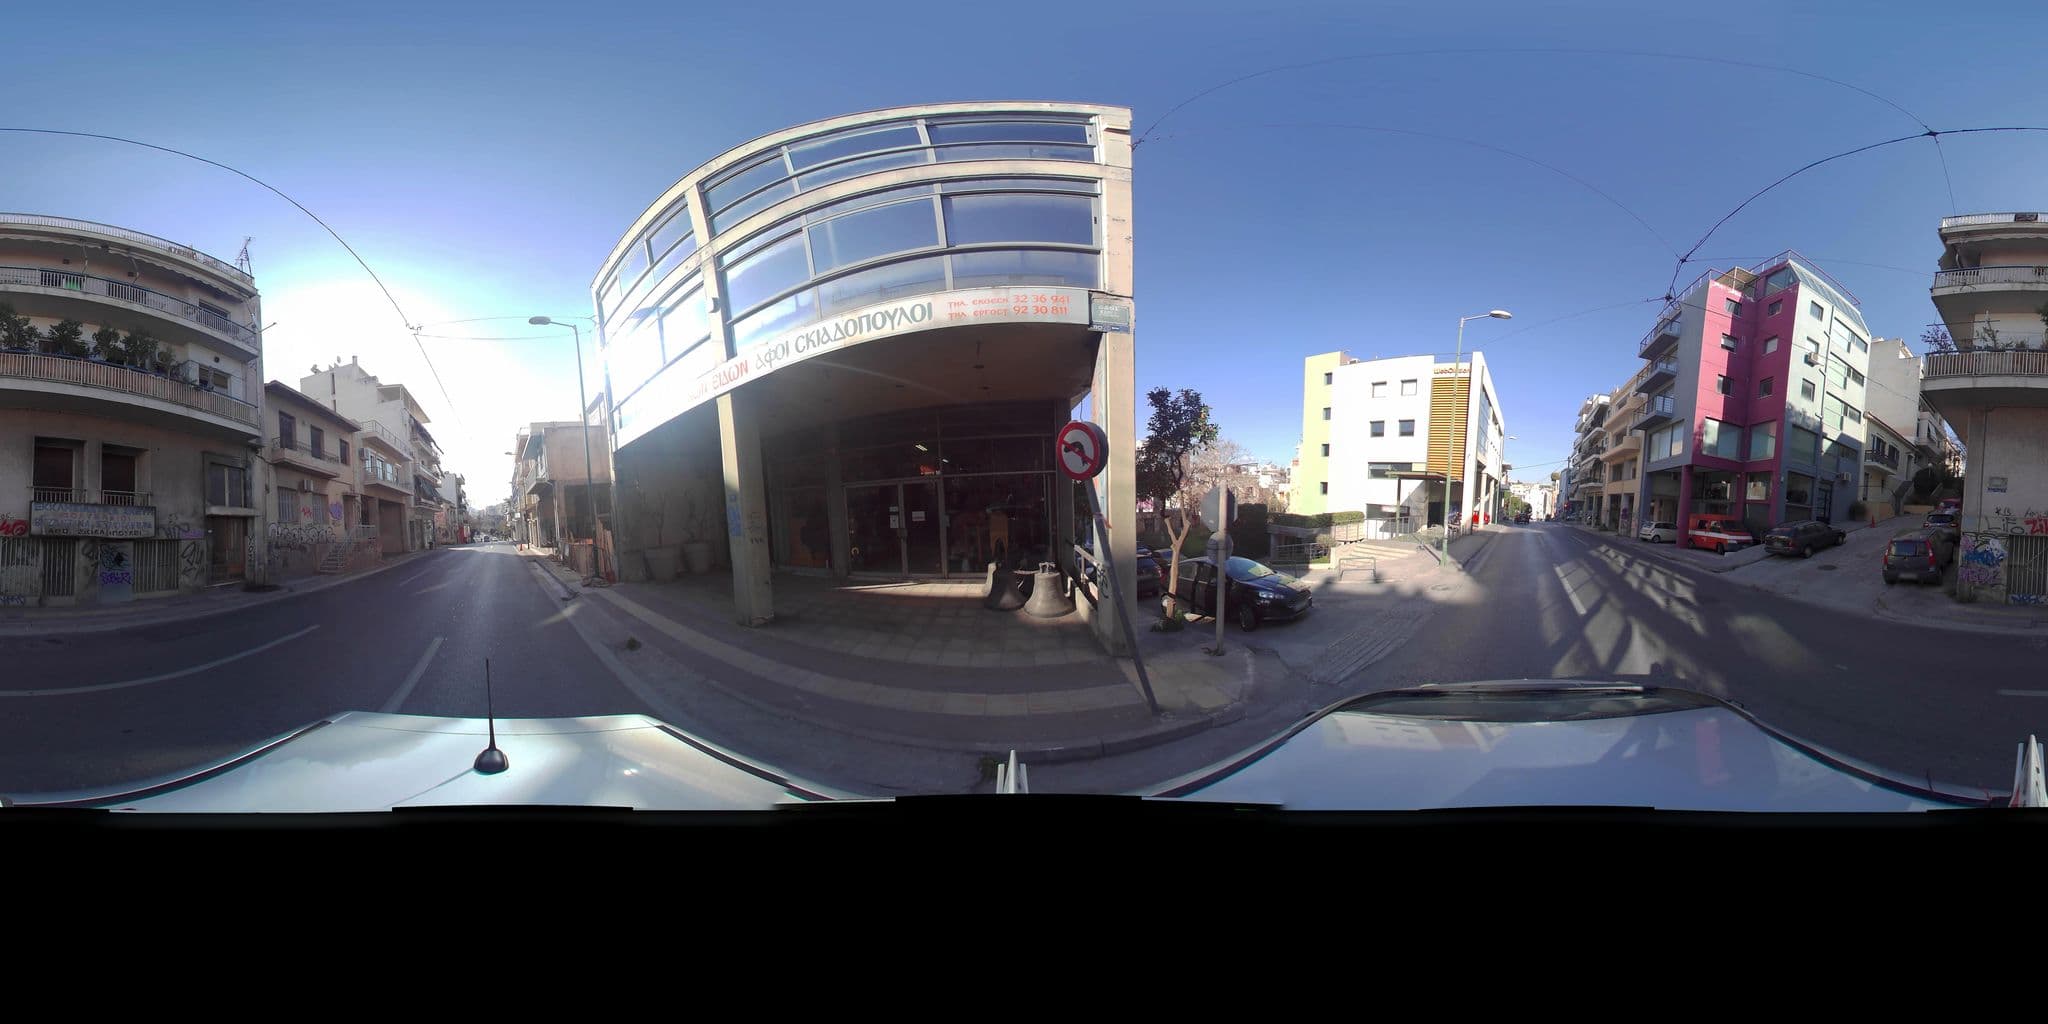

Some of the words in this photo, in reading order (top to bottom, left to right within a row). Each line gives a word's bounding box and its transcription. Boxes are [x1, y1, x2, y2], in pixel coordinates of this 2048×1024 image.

[1014, 294, 1028, 304] 32
[1032, 294, 1047, 304] 36
[1013, 305, 1028, 315] 92
[1032, 305, 1048, 315] 30
